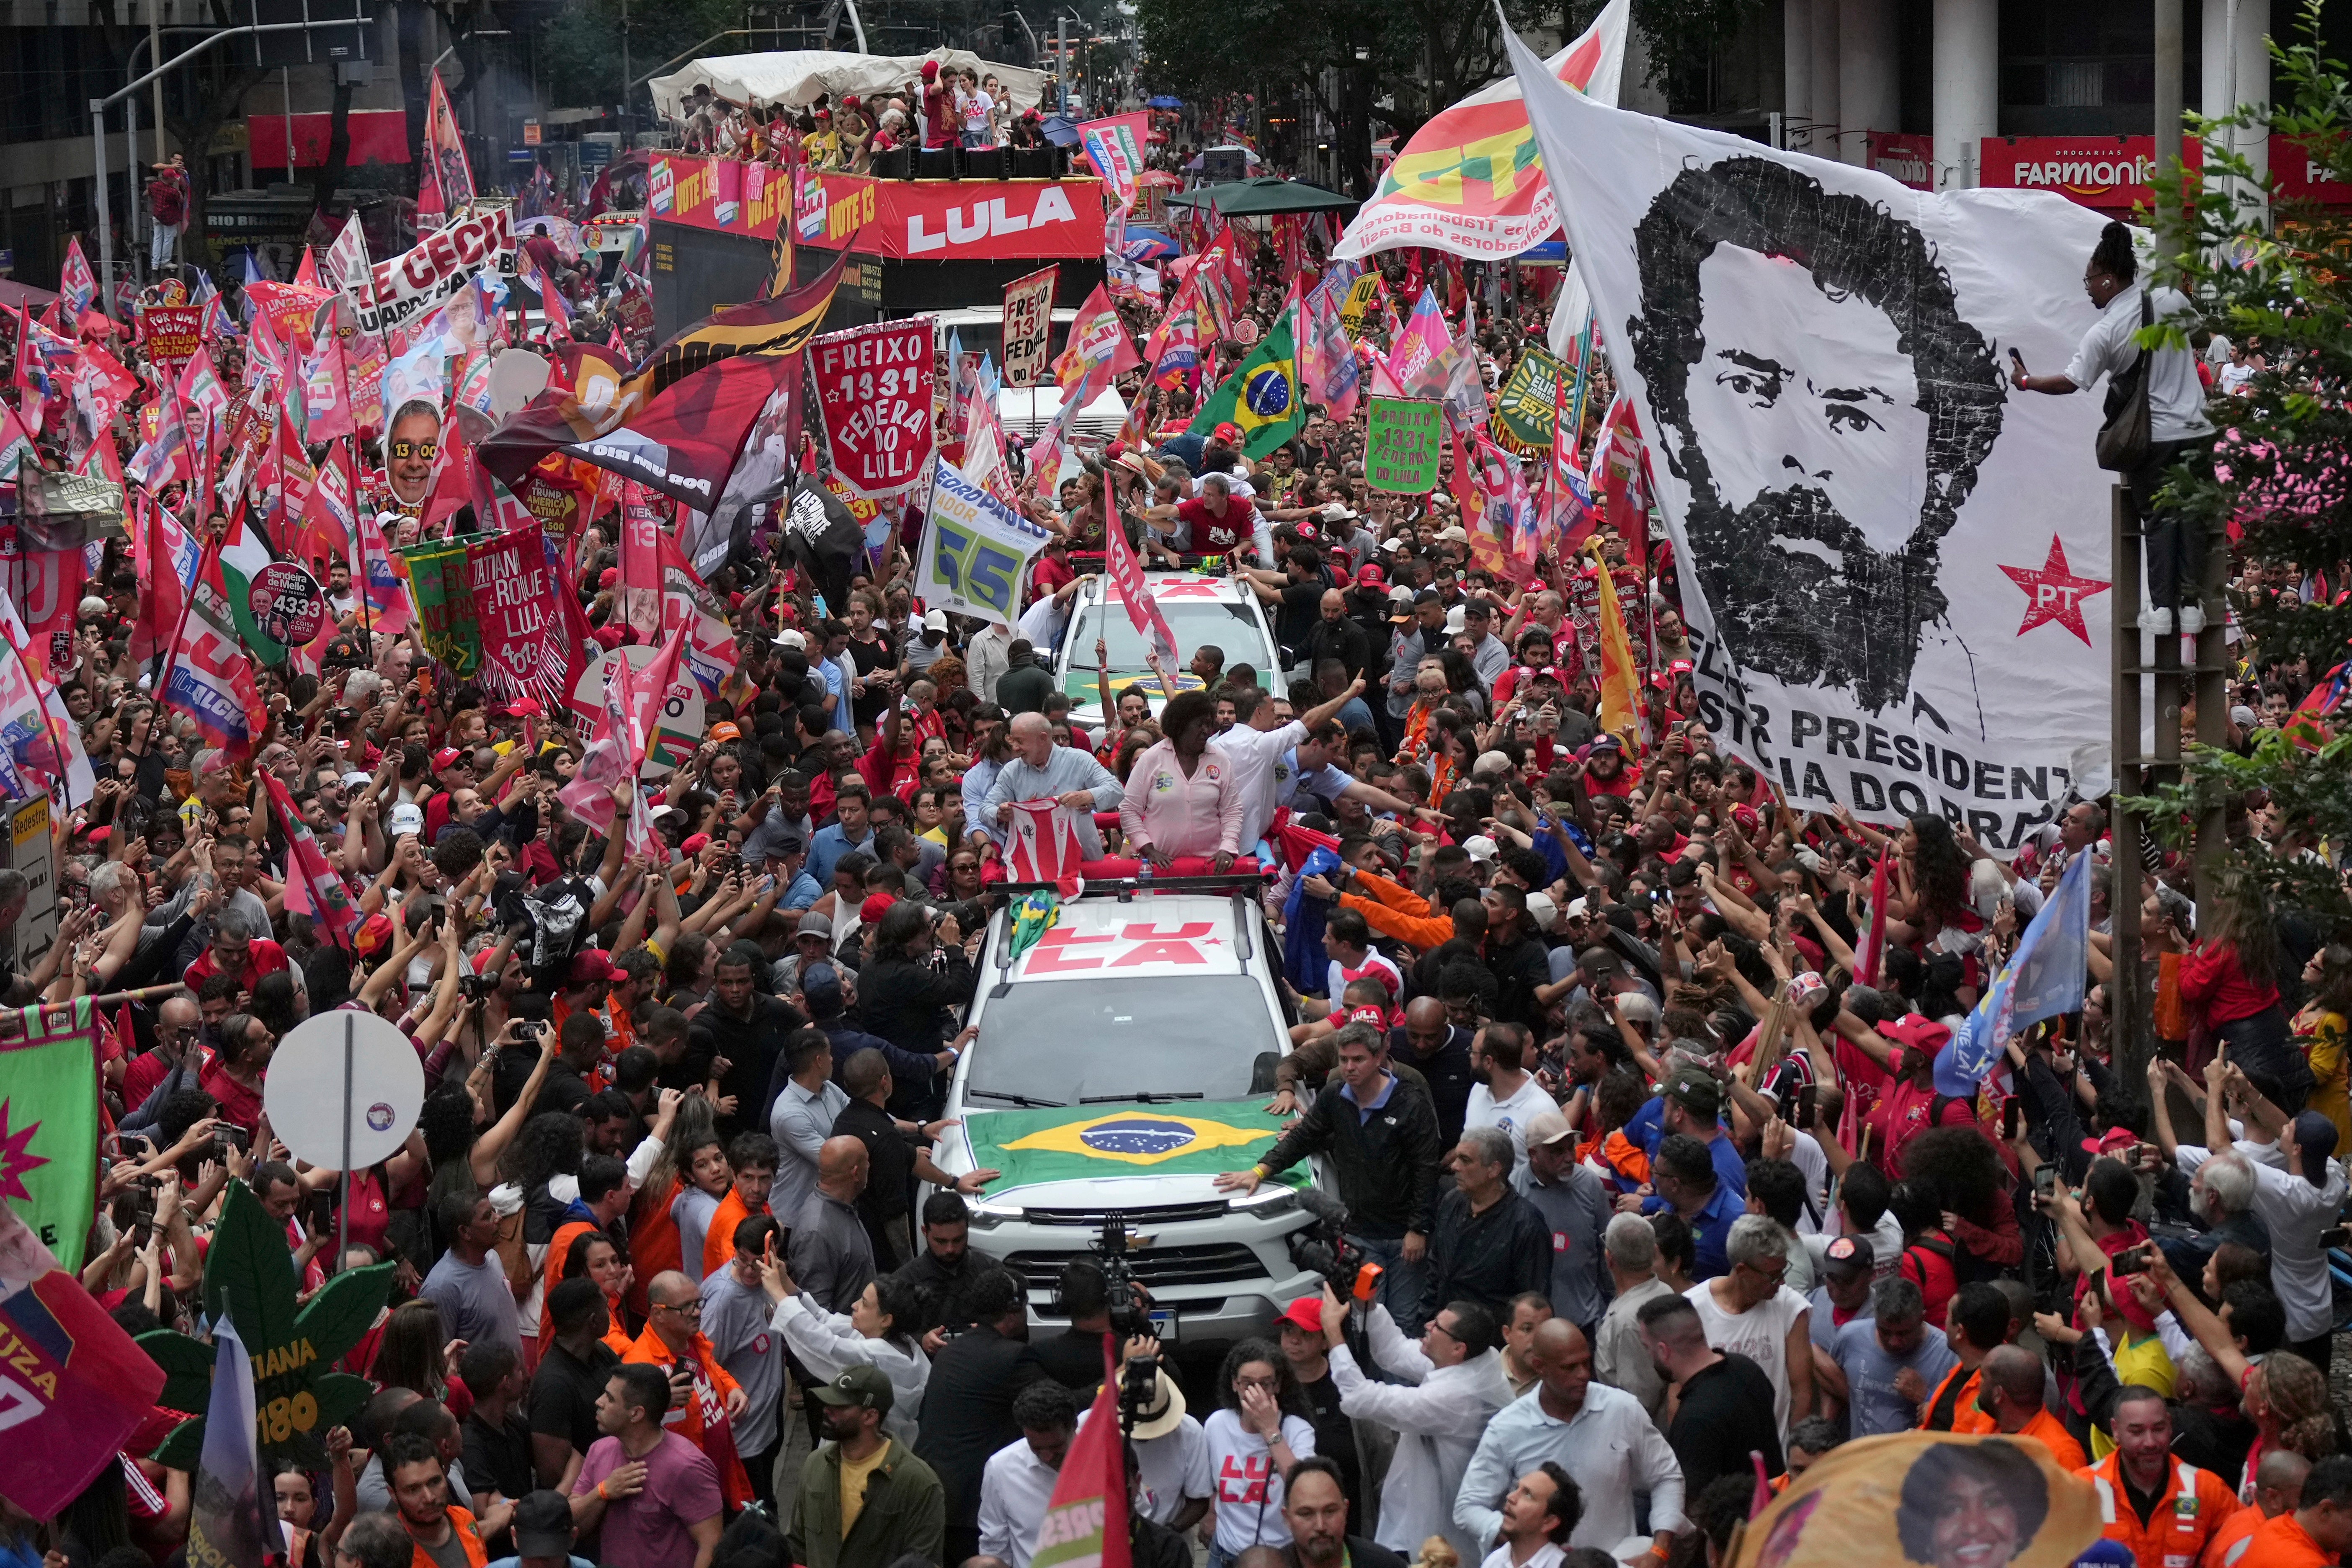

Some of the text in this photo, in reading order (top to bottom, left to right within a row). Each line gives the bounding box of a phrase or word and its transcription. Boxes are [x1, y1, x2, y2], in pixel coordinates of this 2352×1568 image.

[1151, 175, 1177, 185] BRAHMA
[676, 172, 699, 216] VOTE
[208, 215, 235, 227] RIO
[829, 183, 875, 241] VOTE 13
[908, 186, 1076, 254] LULA
[149, 312, 198, 326] POR UMA
[157, 323, 187, 335] NOVA
[150, 335, 199, 346] CULTURA
[823, 335, 922, 374] FREIXO
[840, 366, 918, 402] 1331
[1014, 368, 1026, 382] DO
[1380, 410, 1432, 426] FREIXO
[875, 426, 898, 452] DO
[1384, 428, 1424, 450] 1331
[395, 443, 410, 457] 13
[1374, 445, 1433, 466] FEDERAL
[864, 449, 912, 479] LULA
[1375, 467, 1421, 485] DO LULA
[532, 487, 561, 498] TRUMP
[530, 505, 561, 517] LATINA
[267, 568, 308, 584] Bandeira
[472, 547, 520, 585] TATIANA
[265, 585, 287, 594] DEPUTADO
[268, 577, 306, 593] de Mello
[496, 567, 544, 607] ROQUE
[1528, 582, 1542, 591] LULA
[273, 594, 321, 618] 4333
[2036, 583, 2079, 610] PT
[296, 619, 315, 629] COISA
[488, 594, 545, 638] É LULA
[502, 641, 539, 674] 4013
[1156, 776, 1173, 789] 55
[1852, 771, 1929, 818] DO
[1036, 922, 1214, 948] LU
[1023, 941, 1208, 975] LA
[1351, 1009, 1378, 1022] LULA
[1220, 1455, 1271, 1480] LU
[1219, 1479, 1271, 1503] LA
